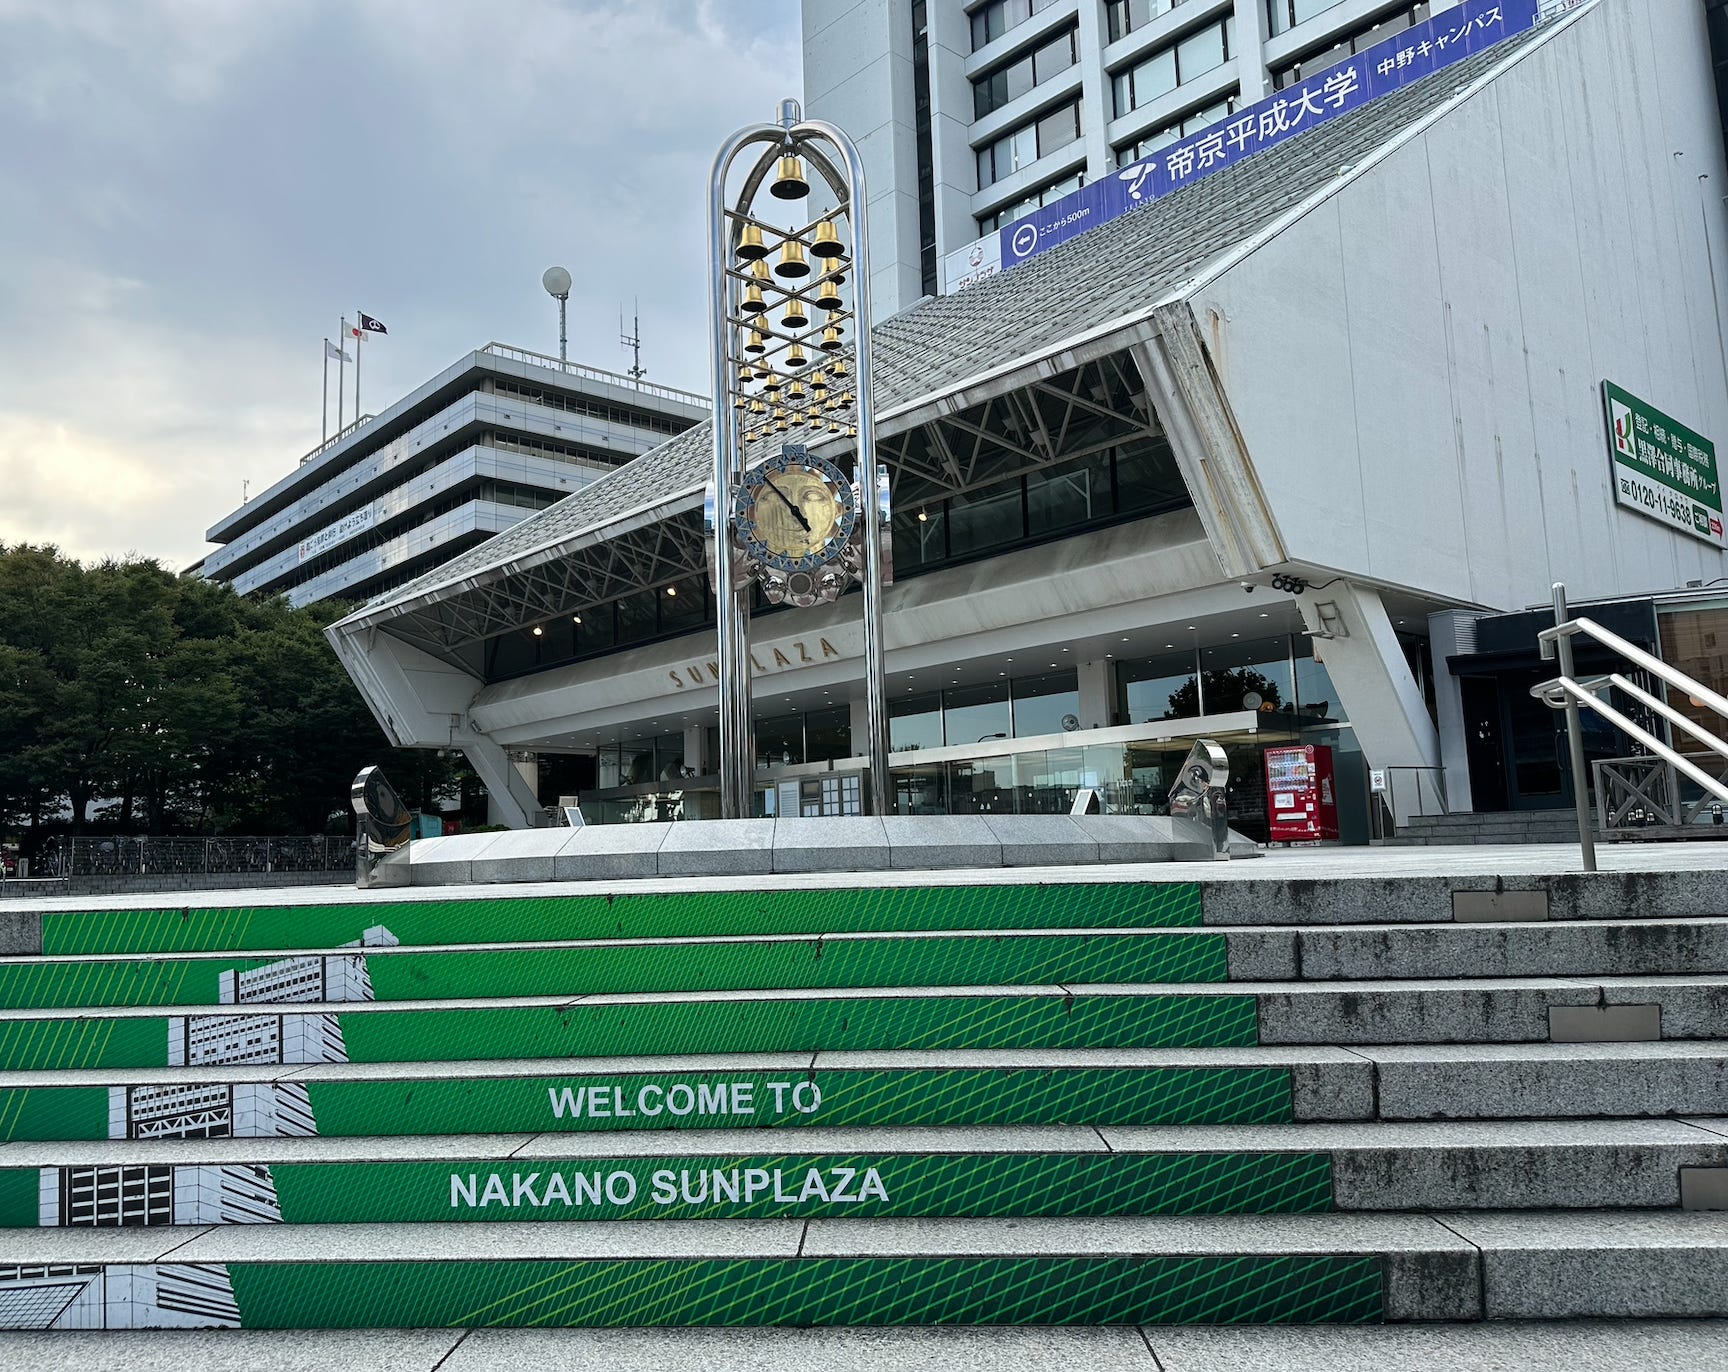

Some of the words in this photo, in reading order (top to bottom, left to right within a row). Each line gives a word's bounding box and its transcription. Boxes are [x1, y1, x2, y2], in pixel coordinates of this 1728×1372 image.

[1167, 66, 1359, 181] 帝京平成大学
[1376, 6, 1503, 77] 中野キャンパス
[1040, 208, 1090, 236] ここから500m
[1631, 480, 1692, 526] 0120-11-9638
[669, 638, 838, 688] SUNLAZA
[548, 1082, 755, 1118] WELCOME
[767, 1081, 822, 1113] TO
[450, 1169, 637, 1207] NAKANO
[651, 1167, 889, 1204] SUNPLAZA
